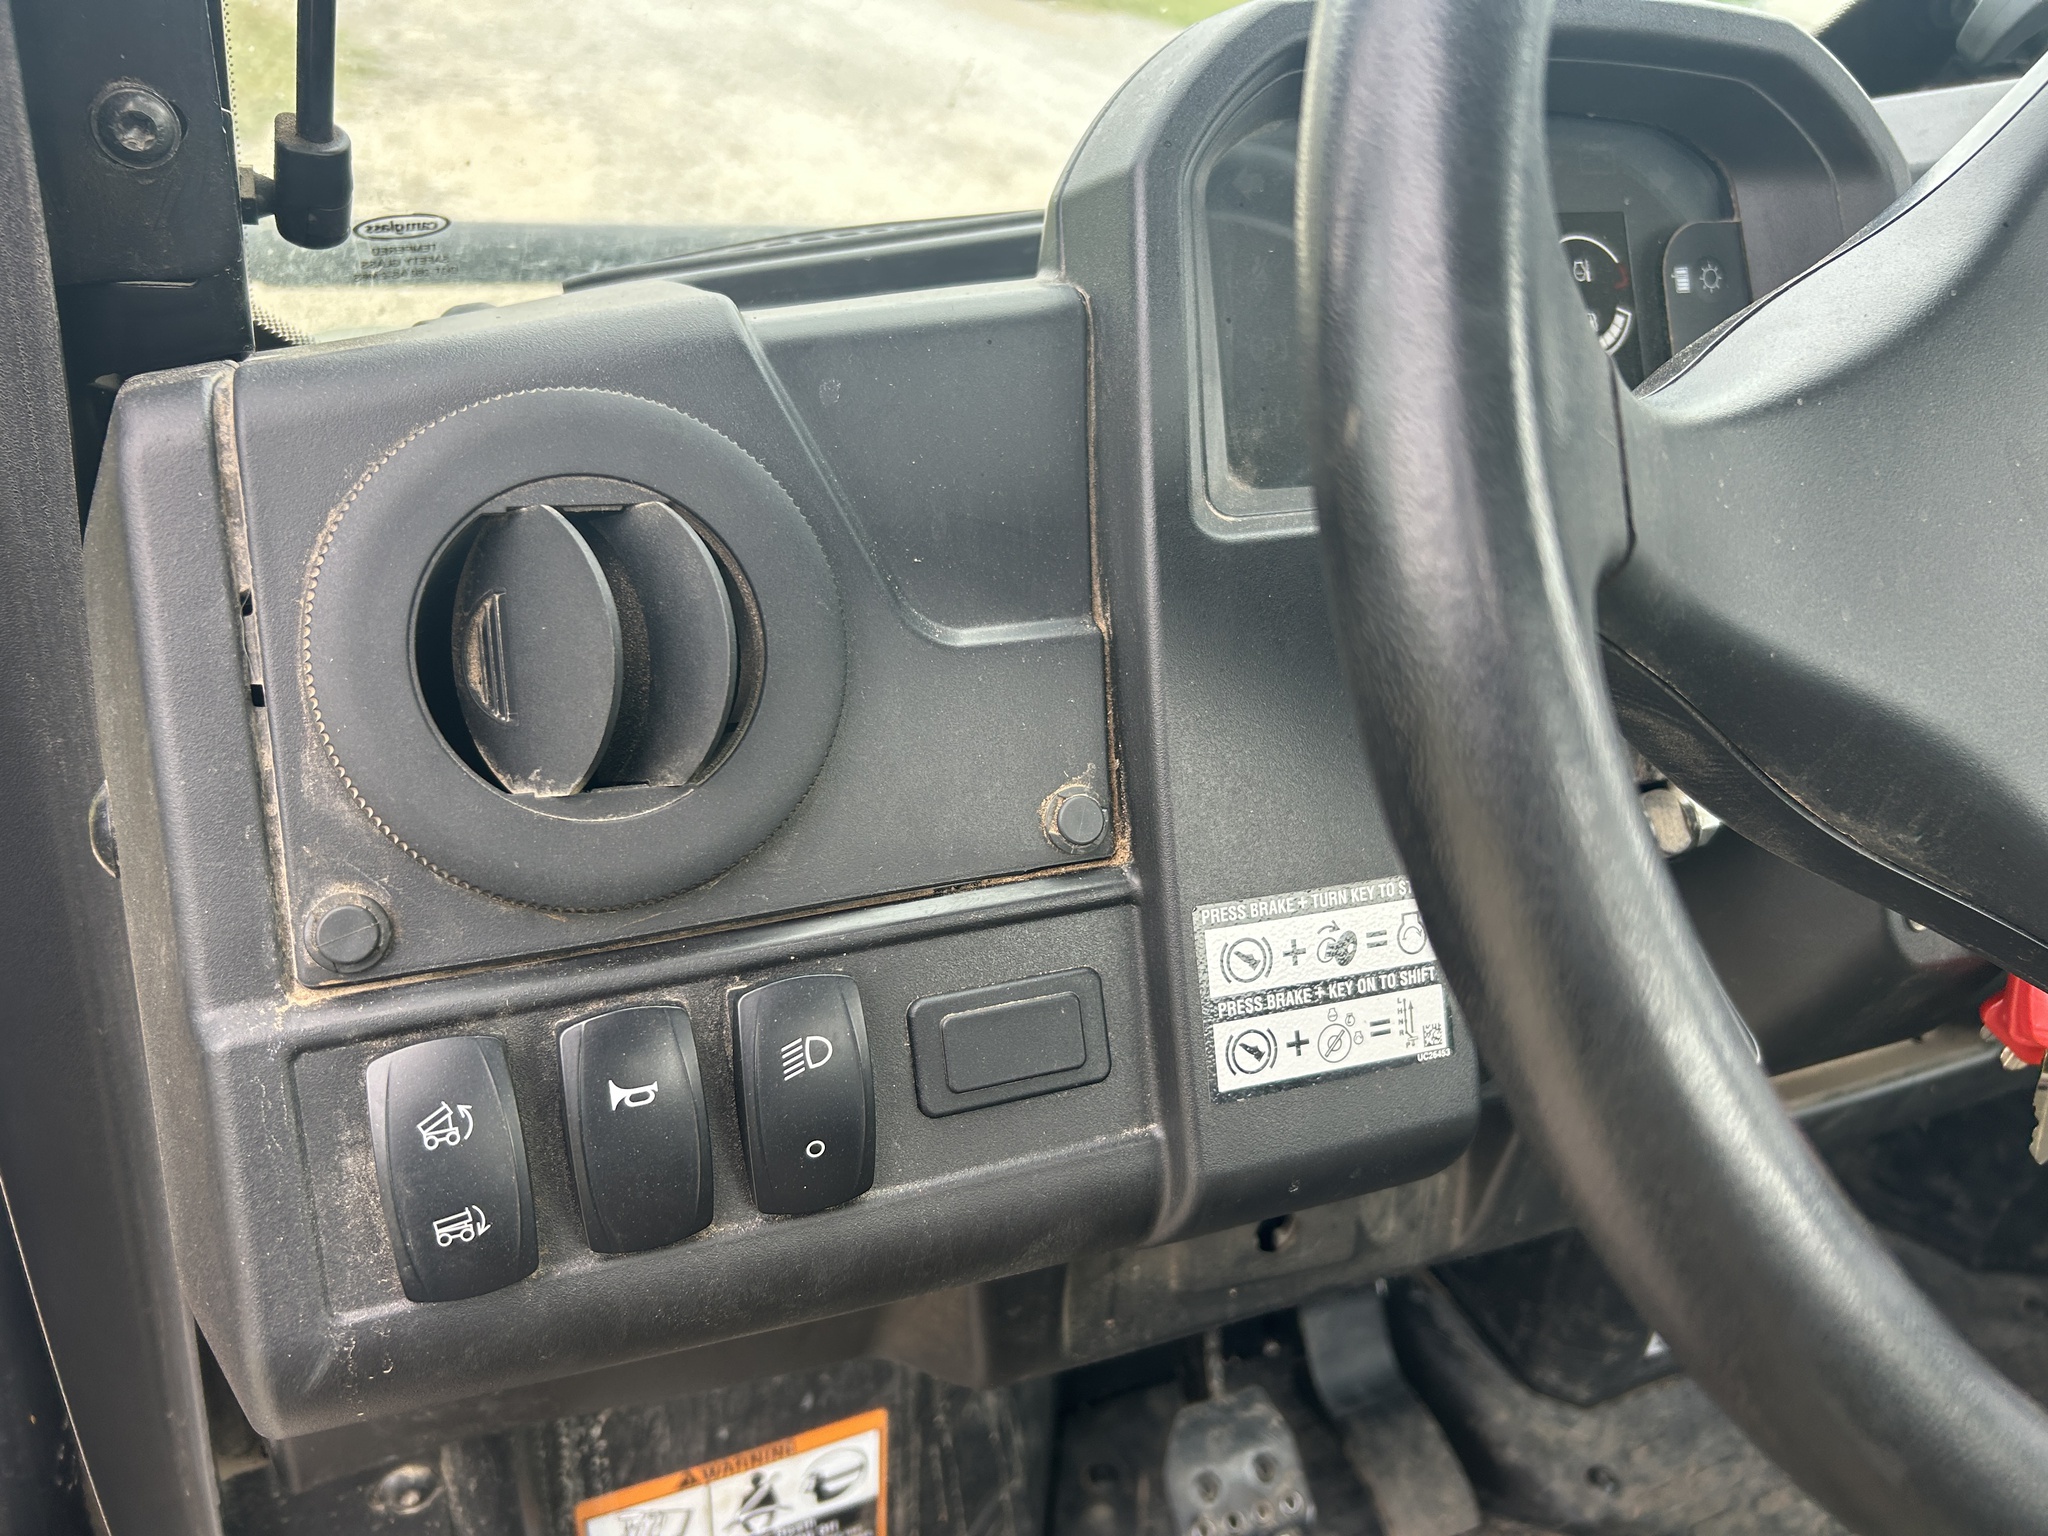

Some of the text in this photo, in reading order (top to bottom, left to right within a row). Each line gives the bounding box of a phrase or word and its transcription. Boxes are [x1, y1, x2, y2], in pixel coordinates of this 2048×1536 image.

[1201, 904, 1247, 925] PRESS
[1249, 897, 1295, 918] BRAKE
[1310, 890, 1348, 909] TURN
[1350, 886, 1375, 904] KEY
[1376, 882, 1395, 899] TO
[1217, 998, 1267, 1019] PRESS
[1267, 988, 1312, 1009] BRAKE
[1328, 980, 1354, 999] KEY
[1357, 976, 1377, 995] ON
[1378, 973, 1397, 991] TO
[1399, 965, 1437, 987] SHIFT
[1416, 1047, 1451, 1062] UC26453
